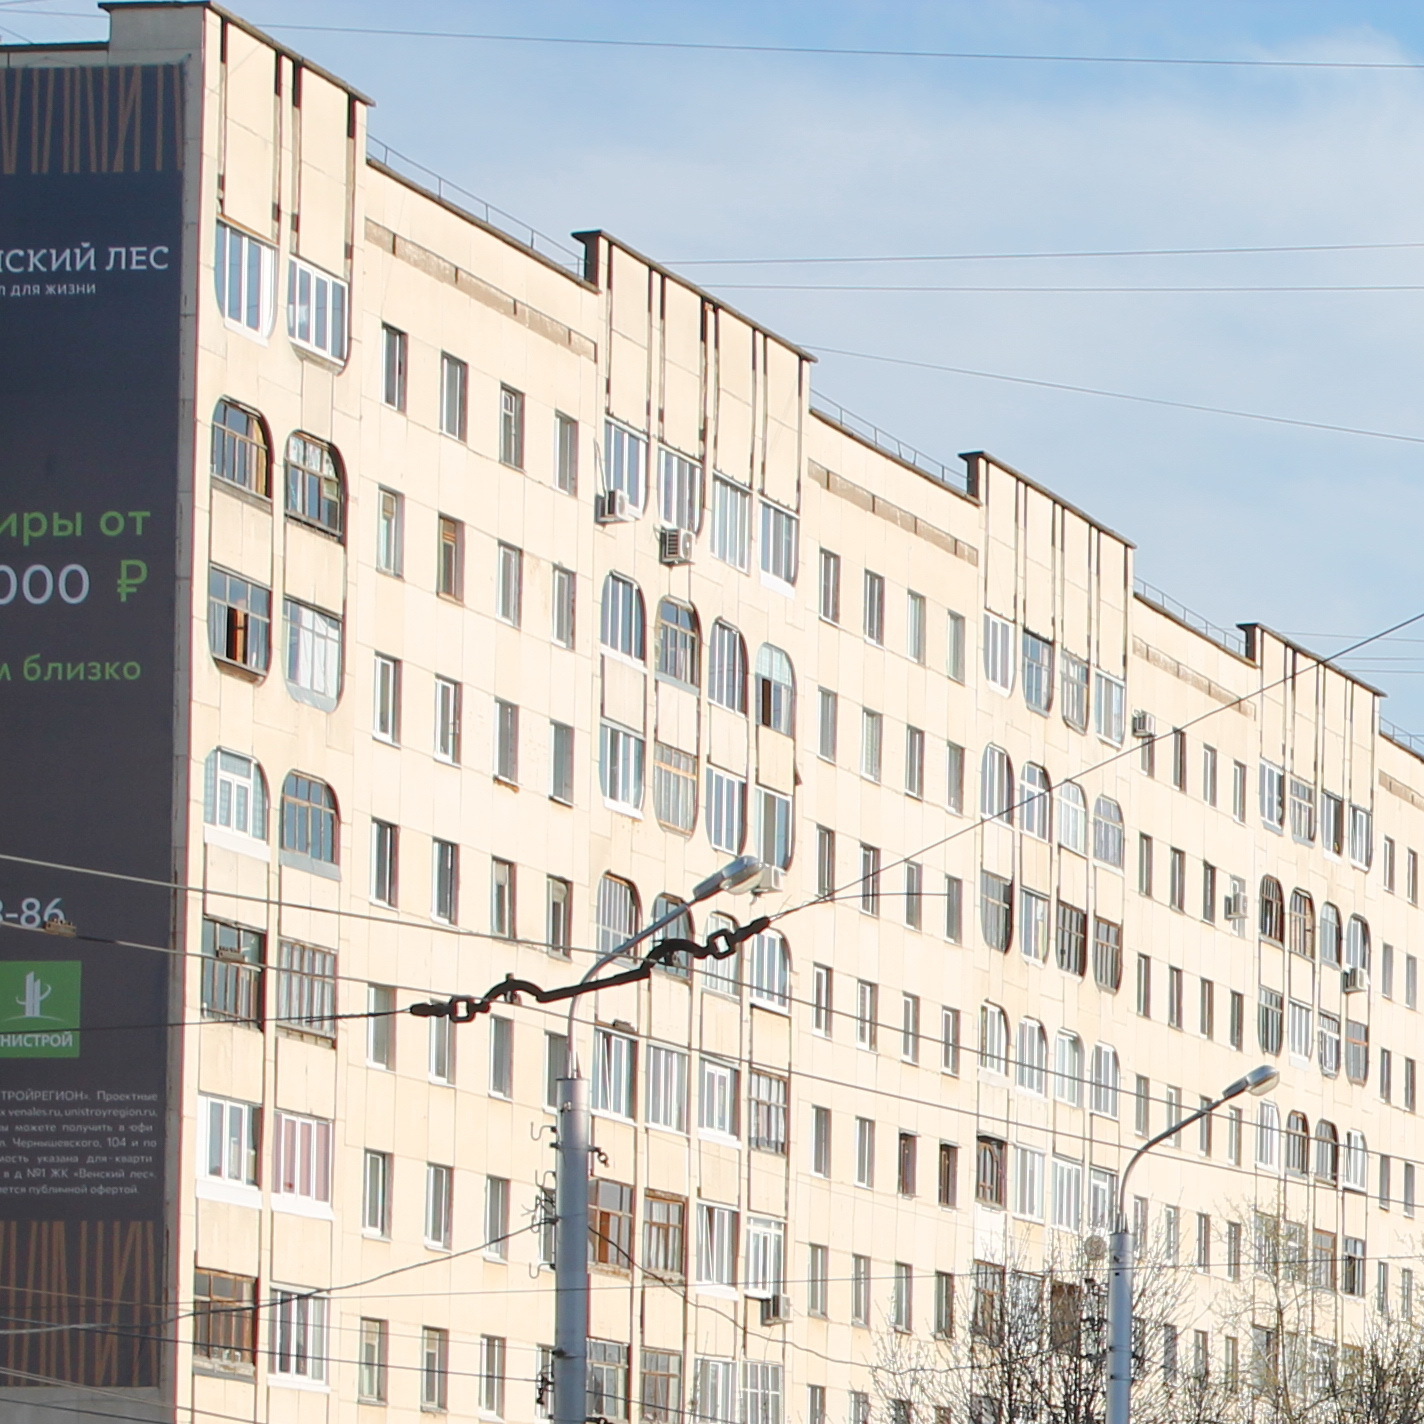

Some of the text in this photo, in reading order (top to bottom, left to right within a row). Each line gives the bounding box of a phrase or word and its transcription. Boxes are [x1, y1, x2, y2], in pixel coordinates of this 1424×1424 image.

[0, 242, 169, 273] СКИЙ ЛЕС
[10, 285, 41, 297] для
[45, 284, 96, 296] жизни
[100, 511, 151, 537] от
[23, 653, 141, 682] близко
[0, 897, 66, 929] -86
[97, 1090, 158, 1102] Проектные
[62, 1125, 113, 1134] получить
[12, 1137, 102, 1149] Чернышевского,
[106, 1137, 126, 1148] 104
[37, 1156, 79, 1165] указана
[50, 1168, 69, 1179] ЖК
[28, 1185, 88, 1196] публичной
